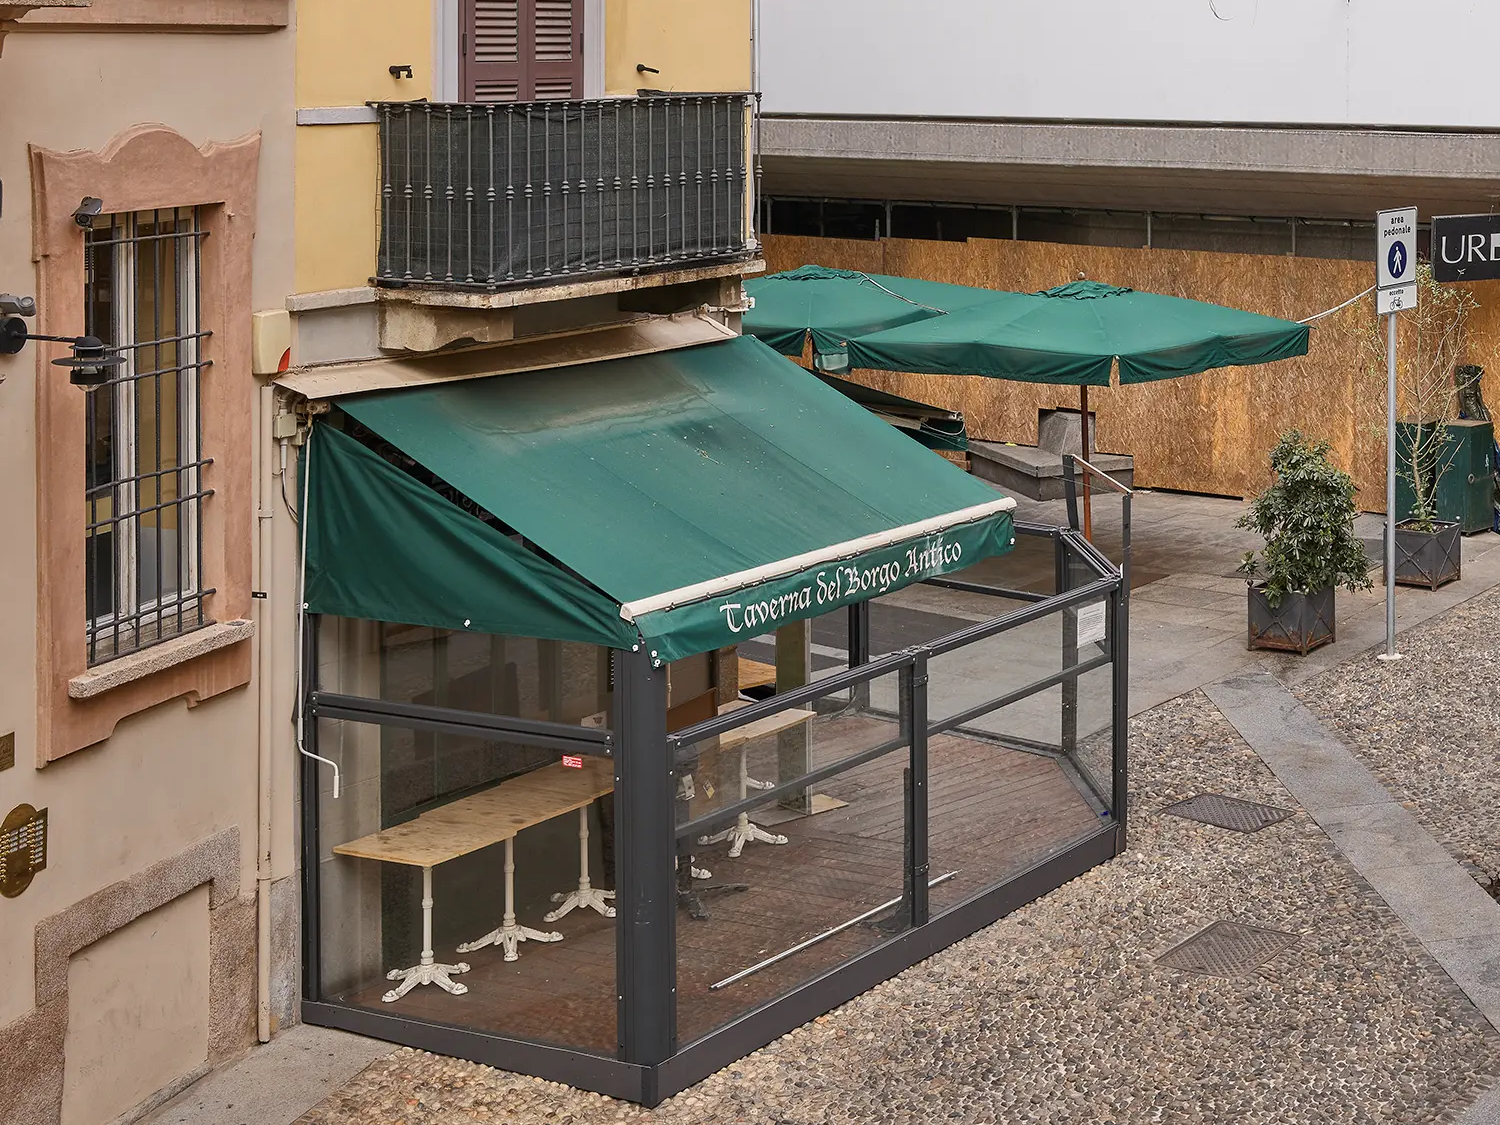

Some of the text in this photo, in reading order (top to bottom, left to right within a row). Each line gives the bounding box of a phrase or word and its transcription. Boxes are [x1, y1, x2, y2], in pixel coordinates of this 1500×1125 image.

[1391, 216, 1404, 225] area
[1383, 224, 1411, 238] pedonale
[1388, 288, 1404, 297] eccetto
[719, 537, 963, 634] Taverna del Borgo Antico
